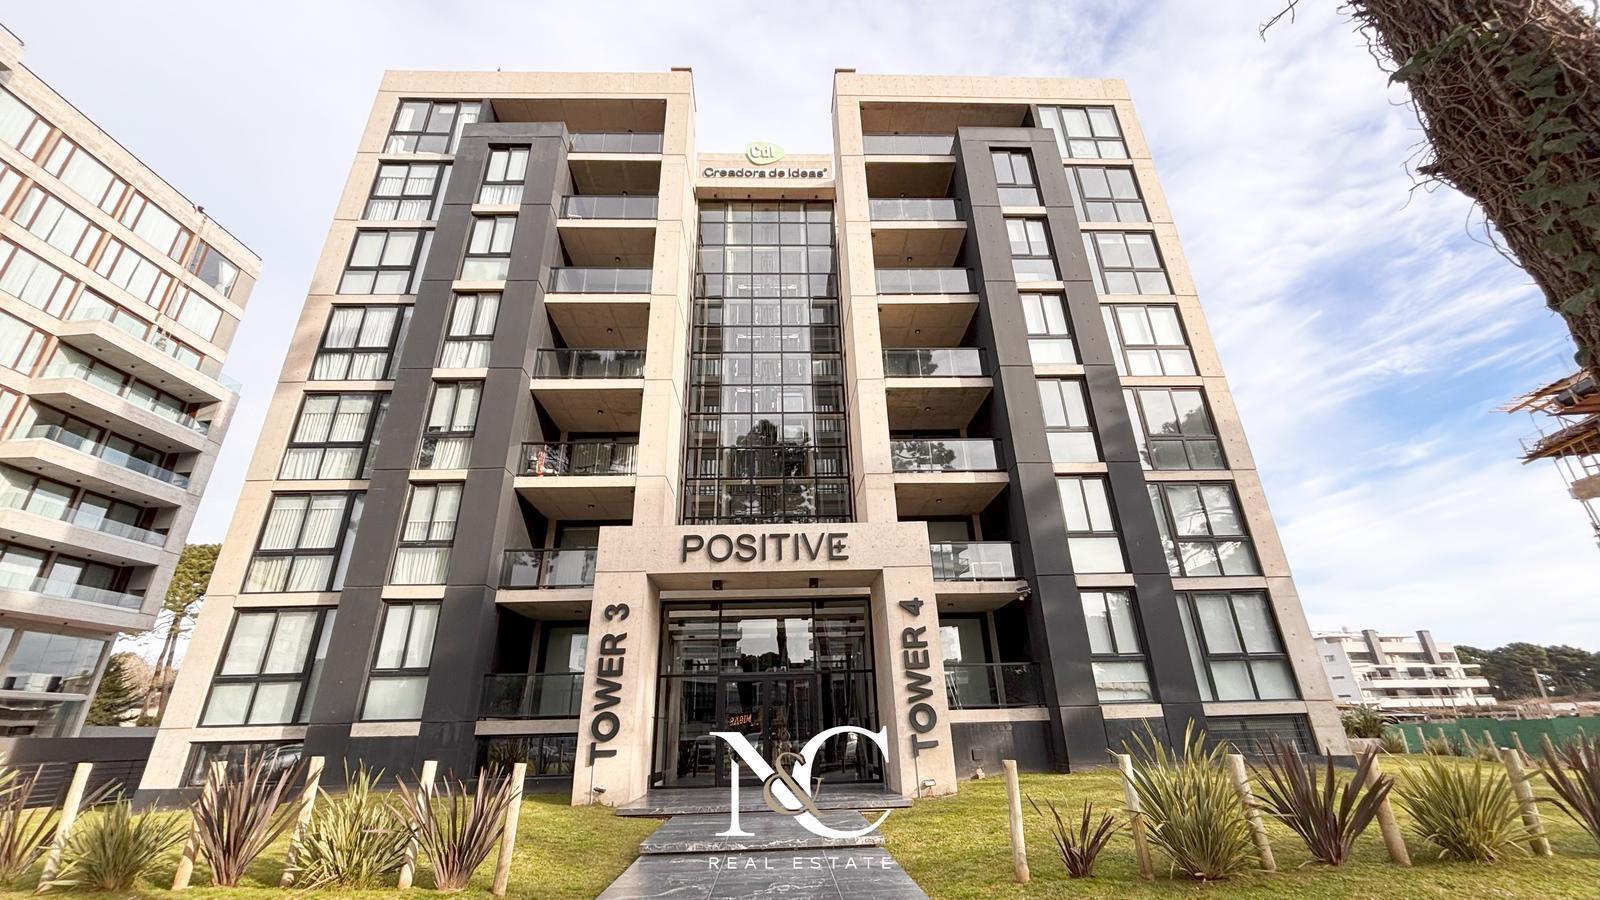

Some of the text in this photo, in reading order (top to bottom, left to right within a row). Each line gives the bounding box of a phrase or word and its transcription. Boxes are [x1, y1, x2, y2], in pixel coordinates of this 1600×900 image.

[704, 167, 766, 178] Creadora
[768, 168, 786, 178] de
[589, 603, 630, 767] TOWER 3
[899, 597, 939, 758] TOWER 4
